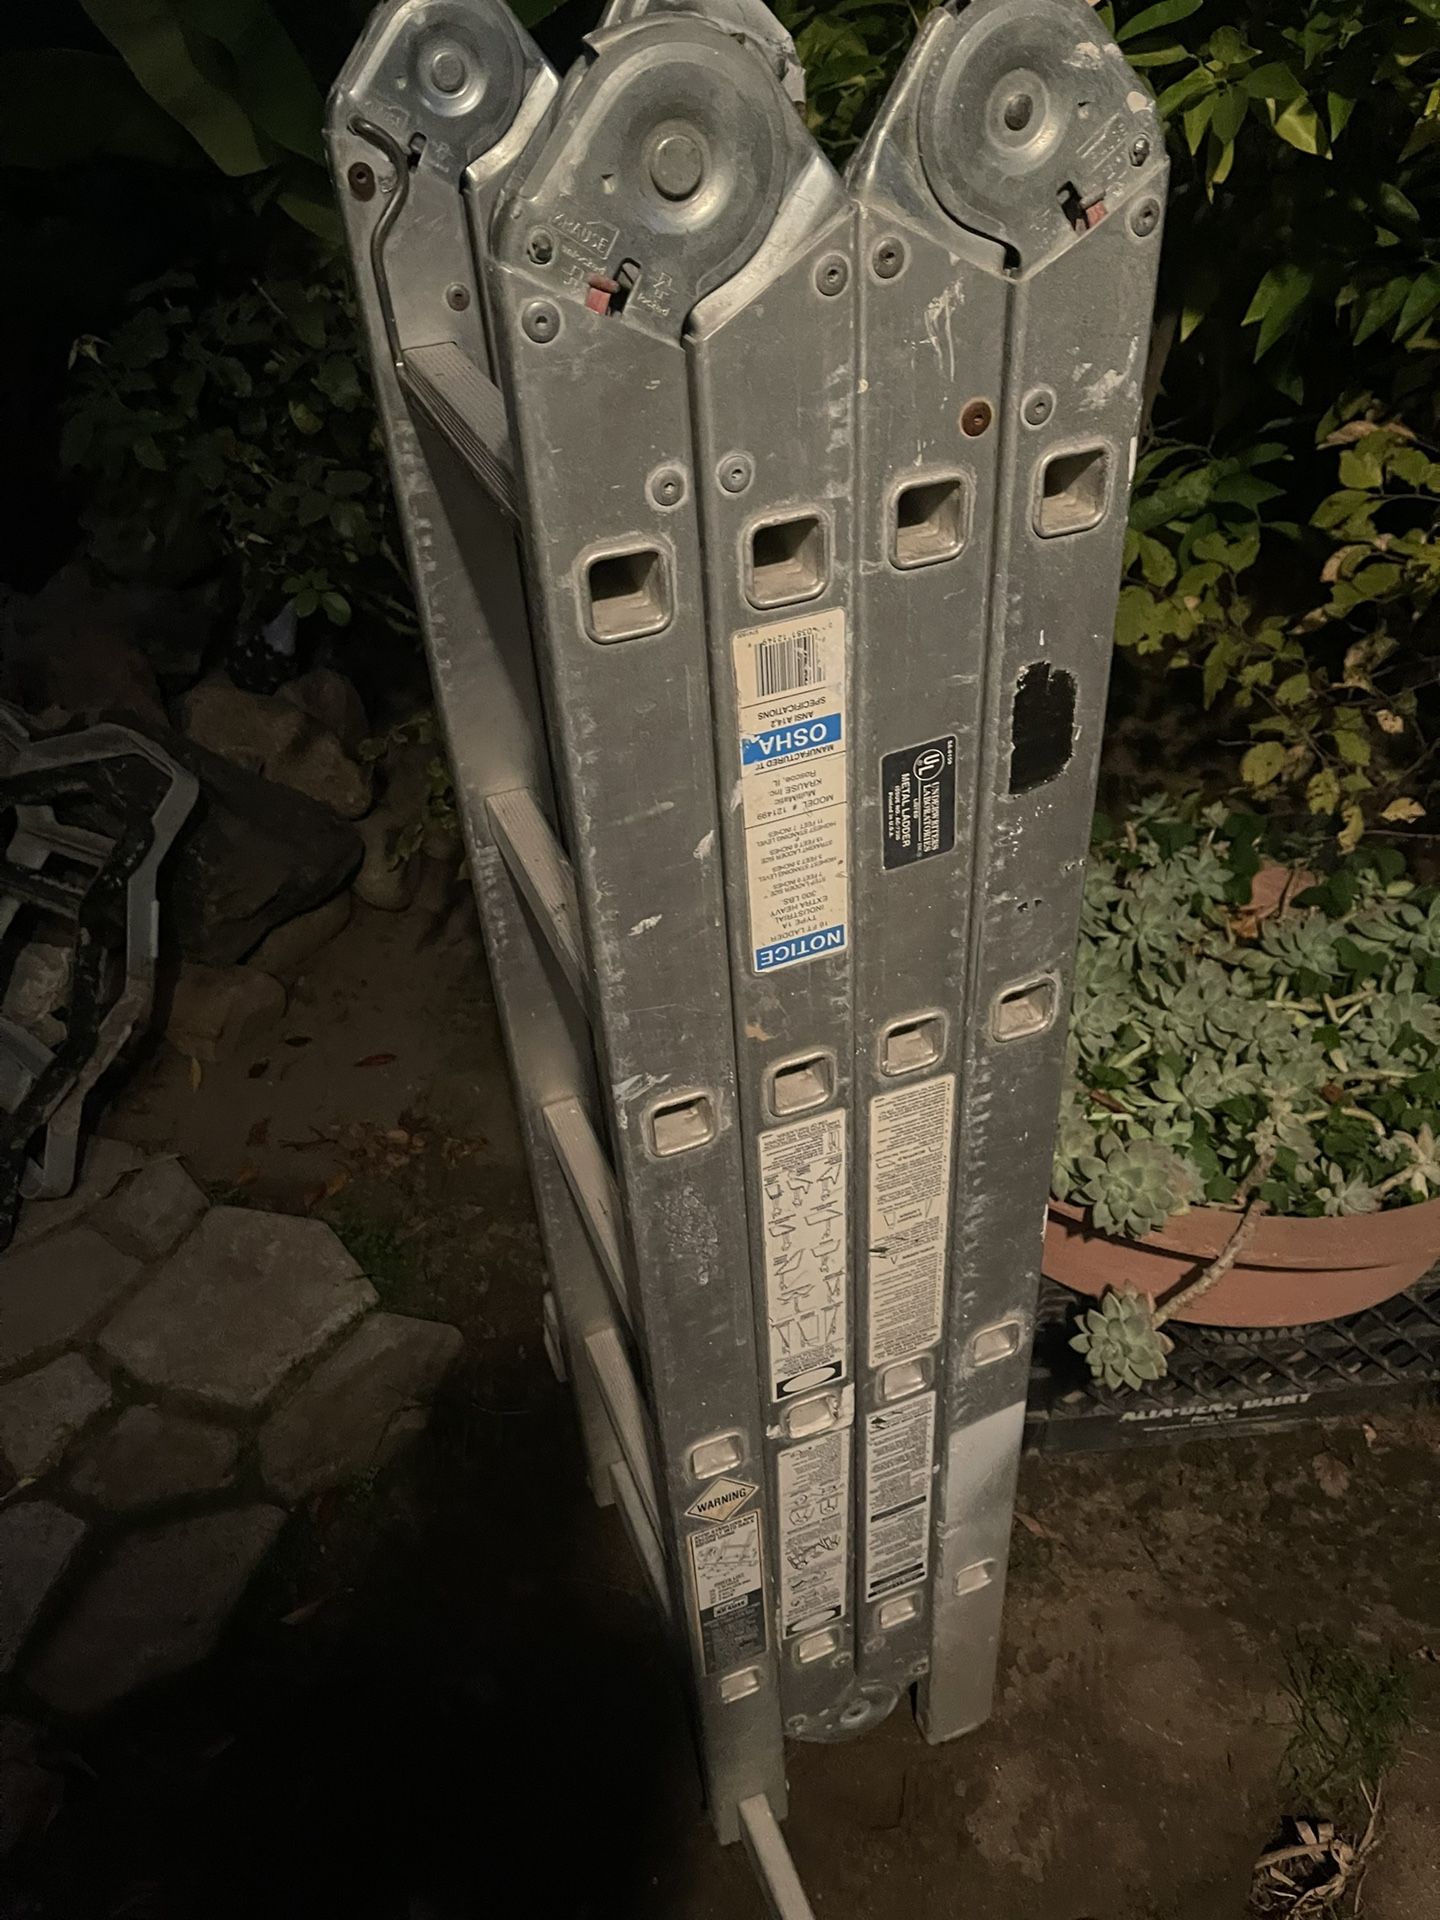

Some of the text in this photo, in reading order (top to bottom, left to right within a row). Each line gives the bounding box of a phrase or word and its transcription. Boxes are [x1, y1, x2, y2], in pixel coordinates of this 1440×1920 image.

[757, 695, 825, 720] SPECIFICATIONS
[793, 710, 813, 721] ANSI
[759, 721, 826, 756] OSHA
[766, 743, 833, 767] MANUFACTURED
[918, 752, 941, 776] UL
[772, 768, 816, 787] Roscoe, IL
[785, 777, 822, 794] KRAUSE
[774, 789, 815, 806] MultiMatic
[802, 793, 833, 808] MODEL
[756, 806, 786, 821] 121499
[901, 773, 911, 848] METAL LADDER
[931, 781, 940, 851] UNDERWRITERS
[800, 820, 815, 829] FEET
[922, 784, 932, 853] LABORATORIES
[767, 826, 791, 838] INCHES
[776, 828, 807, 842] STANDING
[768, 844, 792, 855] INCHES
[799, 838, 814, 847] FEET
[775, 848, 800, 860] LADDER
[802, 855, 816, 864] FEET
[771, 861, 794, 872] INCHES
[777, 863, 808, 877] STANDING
[758, 872, 776, 882] LEVEL
[772, 878, 795, 890] INCHES
[802, 872, 817, 881] FEET
[801, 890, 816, 900] 300
[768, 894, 828, 918] EXTRA HEAVY
[774, 904, 824, 924] INDUSTRIAL
[795, 914, 816, 925] TYPE
[769, 927, 804, 943] LADDER
[806, 924, 817, 932] FT
[760, 929, 839, 965] NOTICE
[696, 1487, 747, 1513] WARNING
